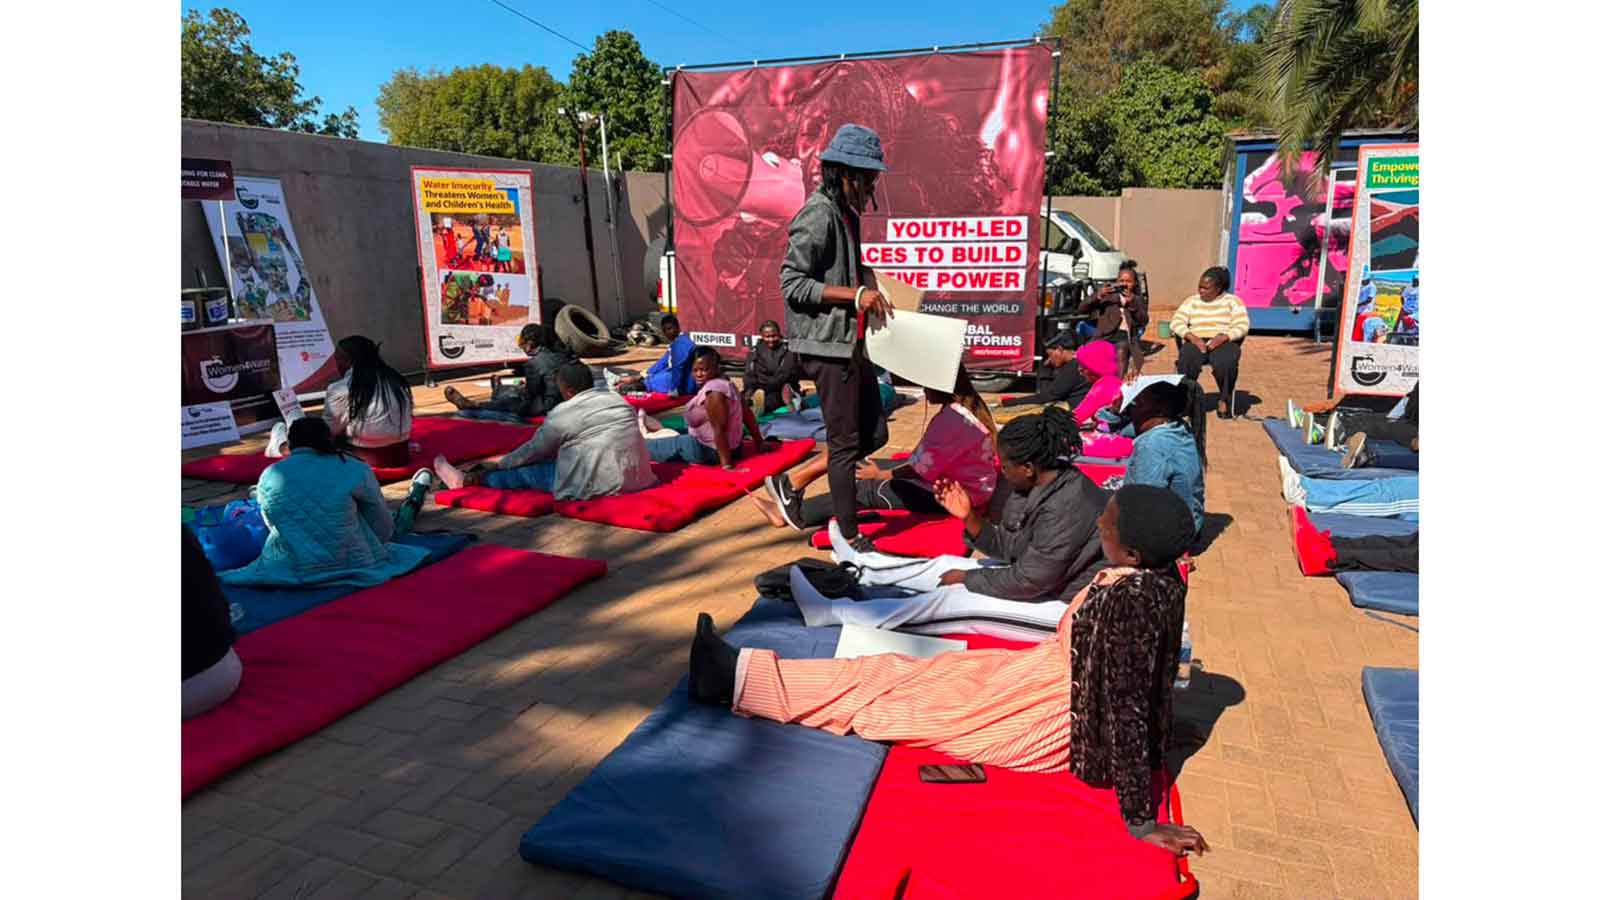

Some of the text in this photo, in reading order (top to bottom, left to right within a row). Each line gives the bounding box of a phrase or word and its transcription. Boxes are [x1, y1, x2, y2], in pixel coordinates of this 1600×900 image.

[424, 180, 492, 192] Water Insecurity
[425, 191, 504, 200] Threatens Women's
[426, 200, 511, 209] and Children's Health
[892, 220, 1022, 238] YOUTH-LED
[862, 246, 1022, 263] CES TO BUILD
[937, 272, 1020, 288] POWER
[961, 303, 980, 313] THE
[982, 303, 1020, 313] WORLD
[693, 334, 733, 344] INSPIRE
